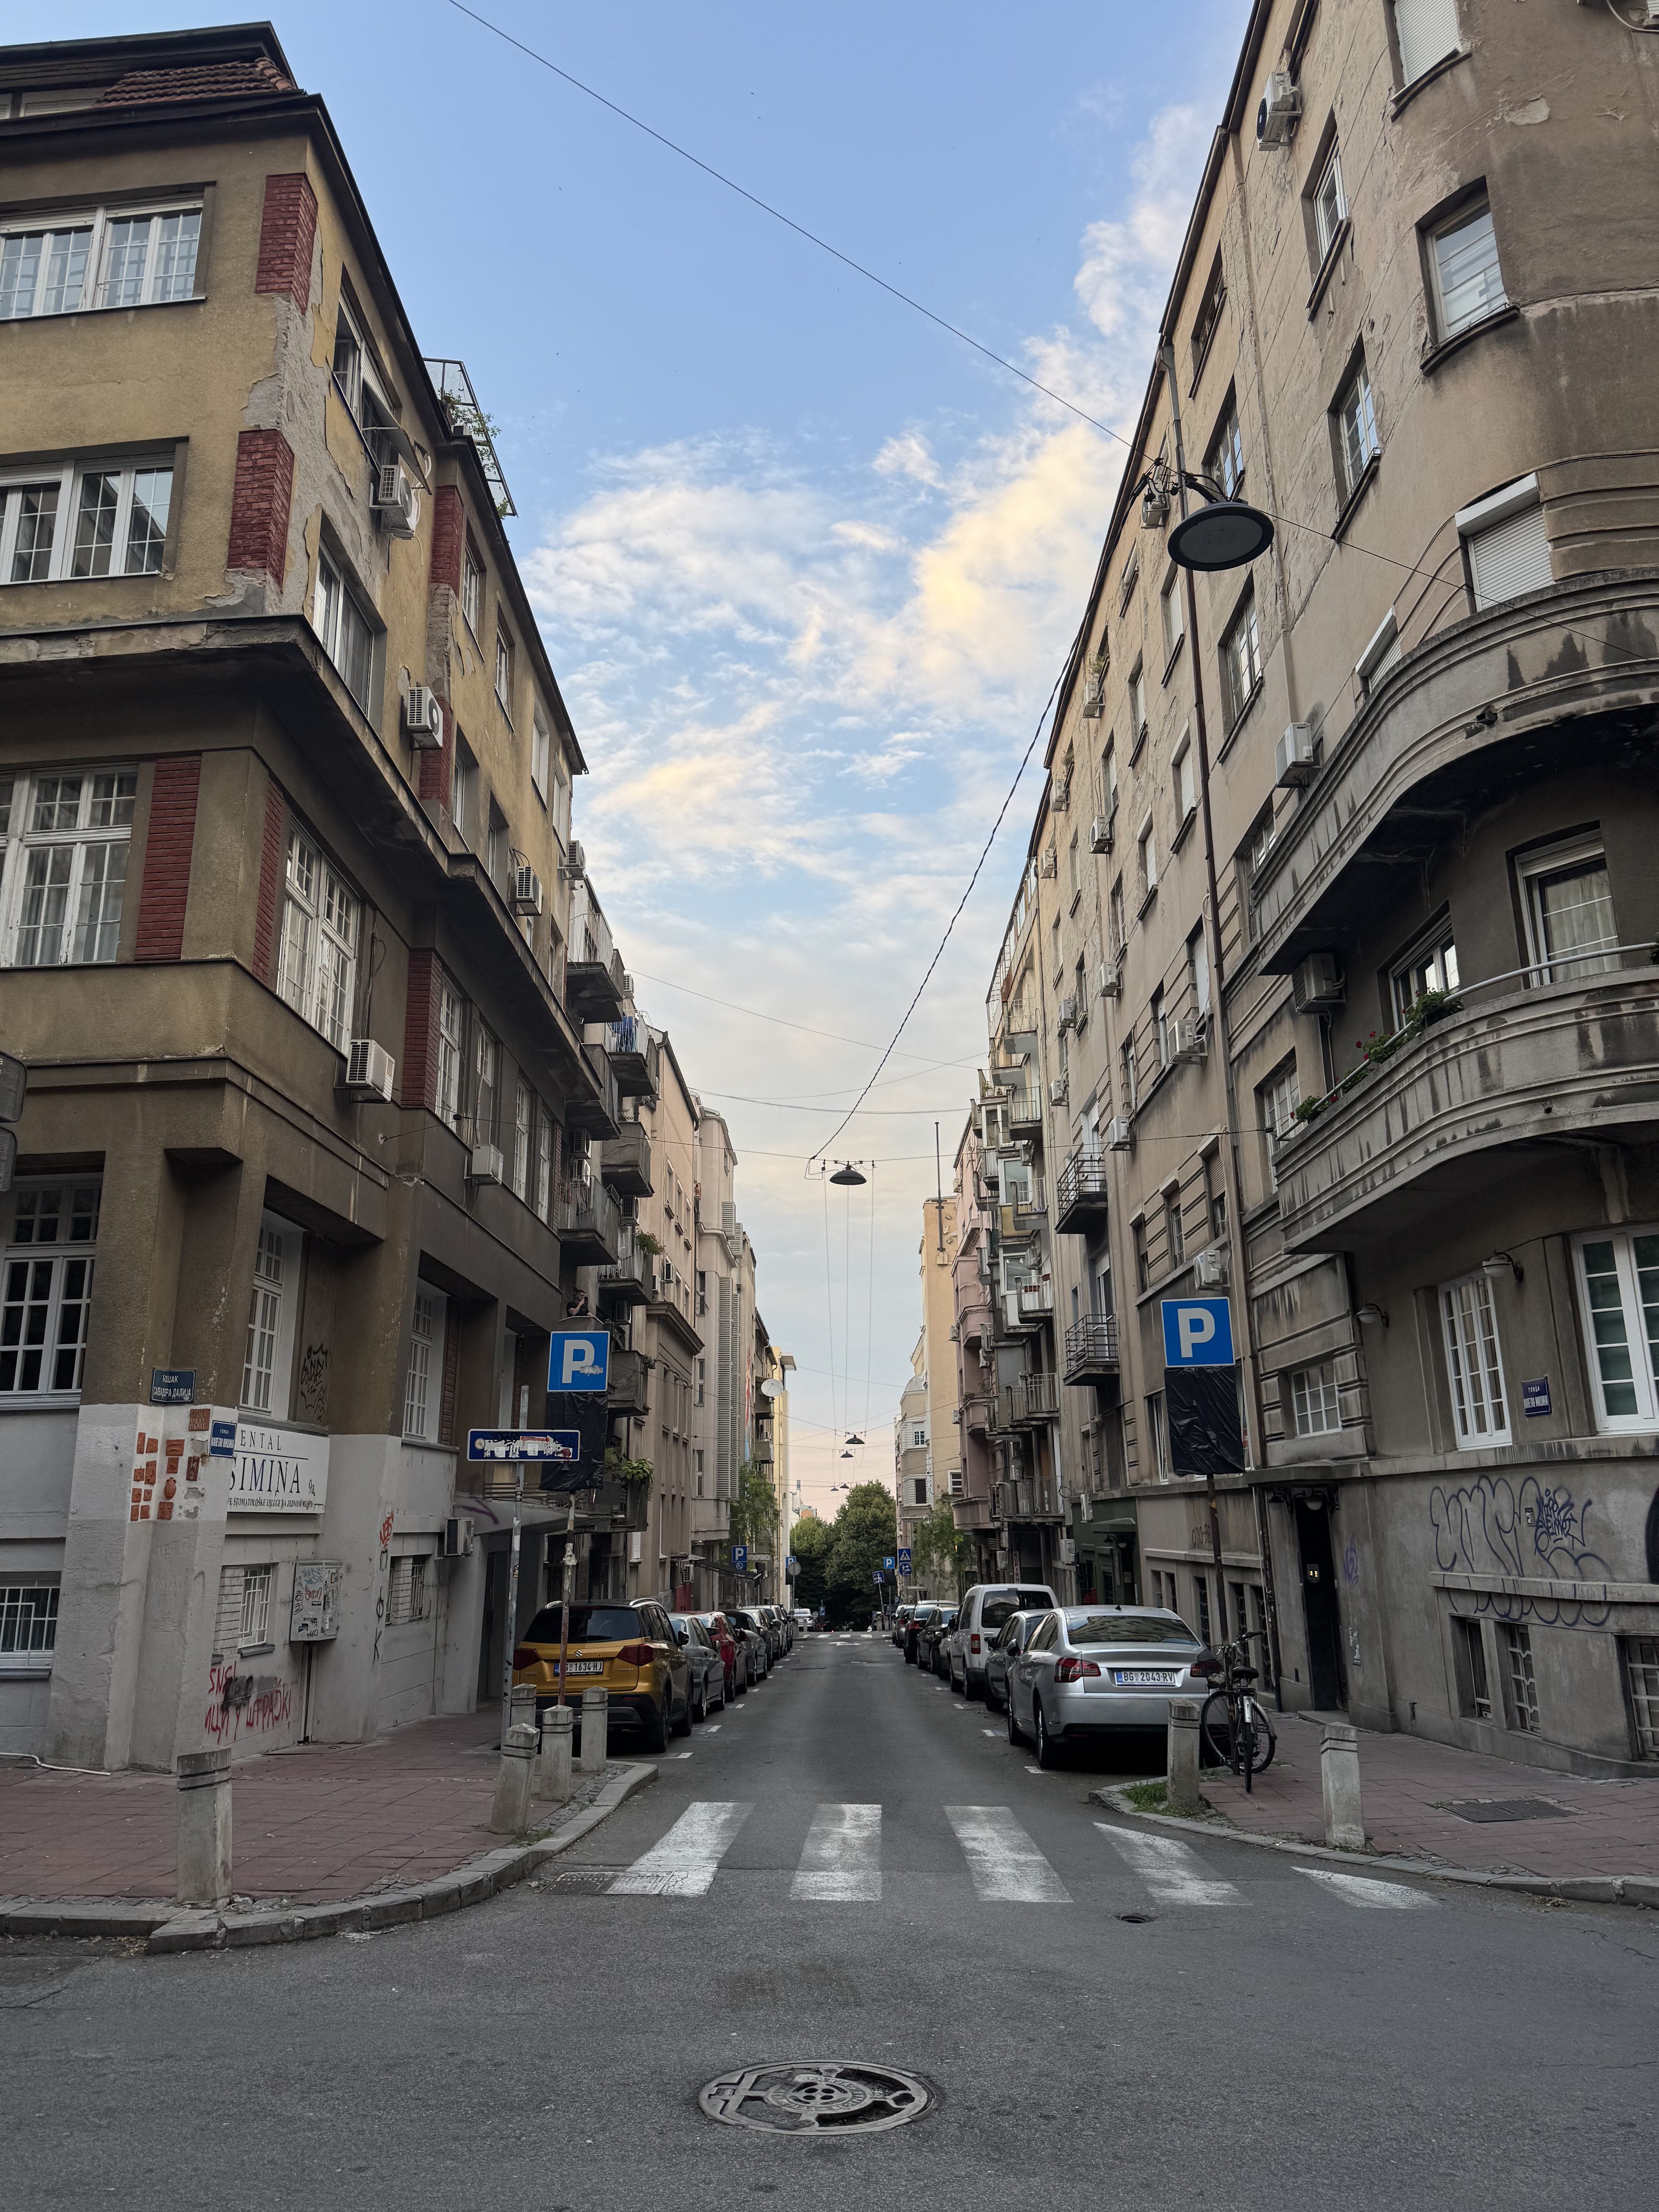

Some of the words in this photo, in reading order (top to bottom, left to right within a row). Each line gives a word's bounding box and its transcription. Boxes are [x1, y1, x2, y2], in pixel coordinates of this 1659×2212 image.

[1178, 1308, 1215, 1357] P
[562, 1340, 595, 1383] P
[172, 1388, 191, 1399] ДАЛИЈА
[240, 1430, 282, 1450] ENTAL
[735, 1547, 744, 1561] P
[886, 1559, 892, 1567] P
[1124, 1672, 1133, 1681] BG
[1140, 1672, 1173, 1681] 2043-RV
